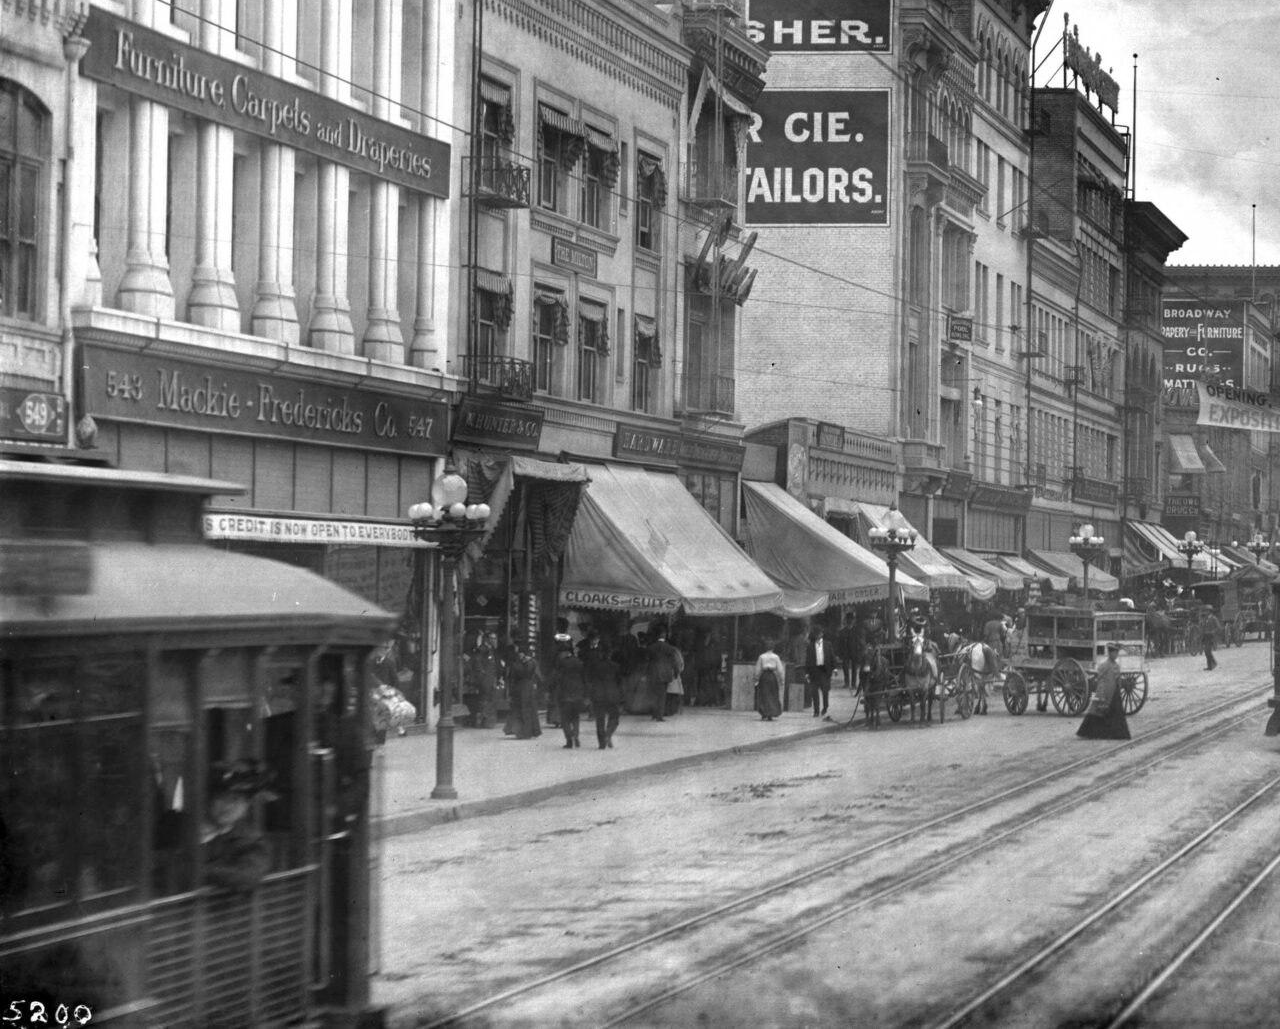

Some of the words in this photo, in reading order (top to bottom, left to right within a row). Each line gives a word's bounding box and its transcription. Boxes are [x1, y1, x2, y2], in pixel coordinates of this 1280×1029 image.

[232, 75, 311, 137] Carpets
[316, 122, 341, 148] and
[347, 116, 432, 179] Draperies
[784, 112, 864, 143] CIE.
[1163, 309, 1232, 318] BROADWAY
[1186, 347, 1213, 357] CO.
[25, 401, 48, 426] 549
[374, 401, 398, 439] Co.
[408, 416, 433, 439] 547
[219, 518, 264, 532] CREDIT
[271, 521, 281, 535] IS
[285, 523, 306, 537] NOW
[311, 523, 341, 538] OPEN
[342, 525, 357, 539] TO
[565, 591, 620, 606] CLOAKS
[632, 596, 677, 609] SUITS
